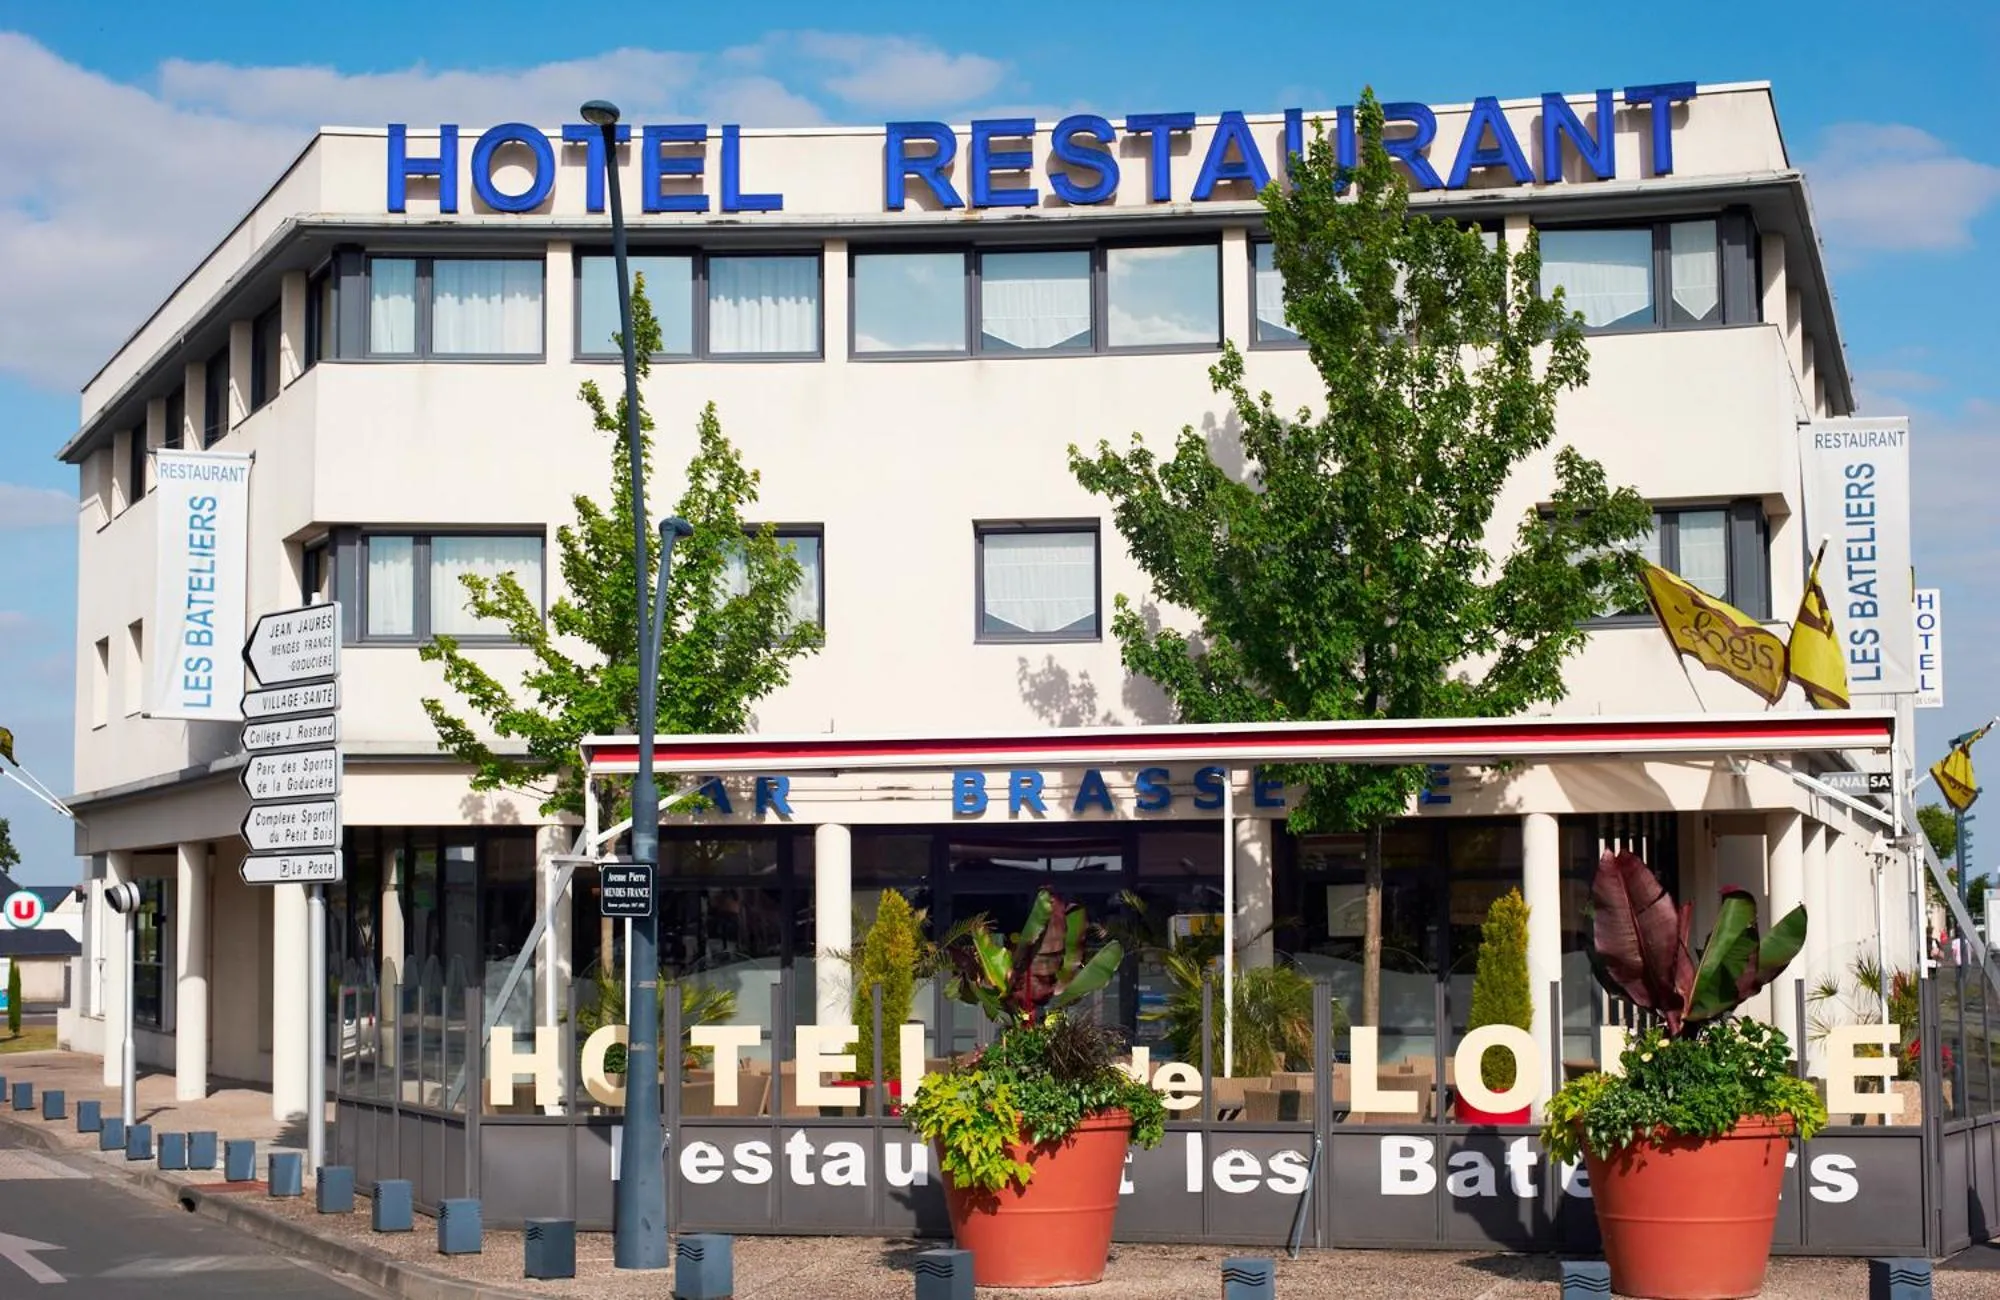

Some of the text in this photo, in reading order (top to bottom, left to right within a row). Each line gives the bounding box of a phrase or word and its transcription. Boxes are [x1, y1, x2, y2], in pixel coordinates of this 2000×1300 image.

[388, 81, 1696, 213] HOTEL RESTAURANT
[1815, 431, 1905, 449] RESTAURANT
[160, 462, 246, 483] RESTAURANT
[1845, 463, 1882, 682] LES BATELIERS
[183, 496, 218, 709] LES BATELIERS
[269, 620, 292, 638] JEAN
[304, 636, 332, 651] FRANCE
[1917, 594, 1935, 691] HOTEL
[297, 722, 333, 738] Rostand
[256, 757, 333, 777] Parc des Sports
[256, 780, 267, 793] de
[272, 780, 281, 792] la
[692, 764, 1451, 815] AR BRASSEE
[1820, 775, 1891, 789] CANALSA
[255, 807, 333, 827] Complexe Sportif
[269, 826, 333, 844] du Petit Bois
[292, 860, 333, 875] La Poste
[627, 888, 649, 897] FRANCE
[14, 901, 34, 919] U
[1350, 1024, 1905, 1115] LOIE
[1186, 1131, 1309, 1194] les
[1380, 1135, 1860, 1204] Bates
